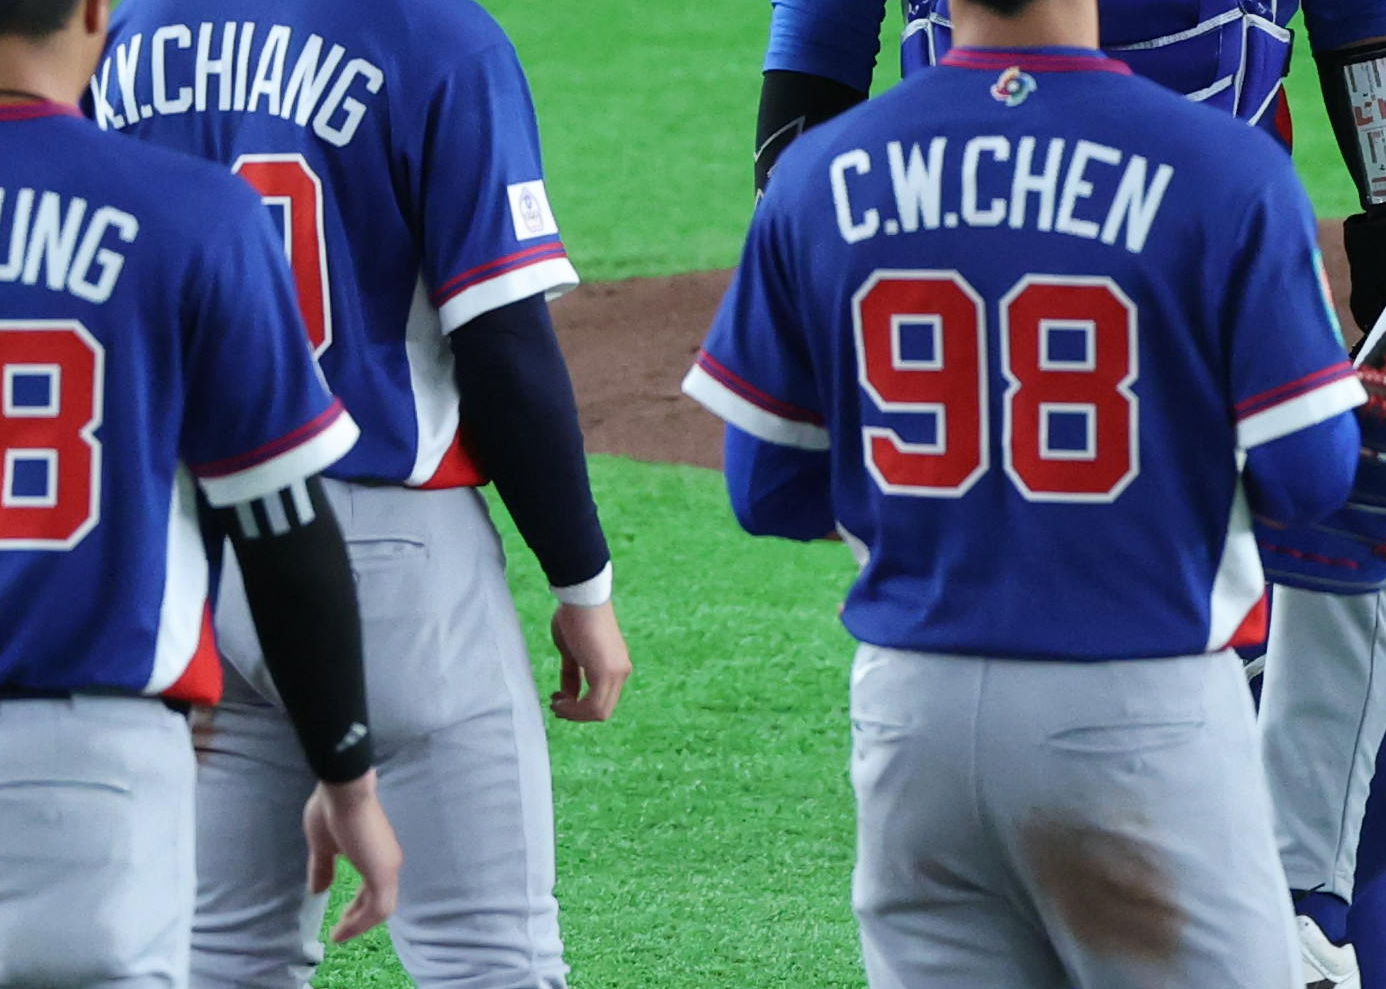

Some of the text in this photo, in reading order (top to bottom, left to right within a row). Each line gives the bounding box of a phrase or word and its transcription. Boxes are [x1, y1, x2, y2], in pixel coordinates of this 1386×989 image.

[829, 135, 1175, 254] C.W.CHEN
[0, 319, 104, 551] 8
[851, 269, 1140, 503] 98
